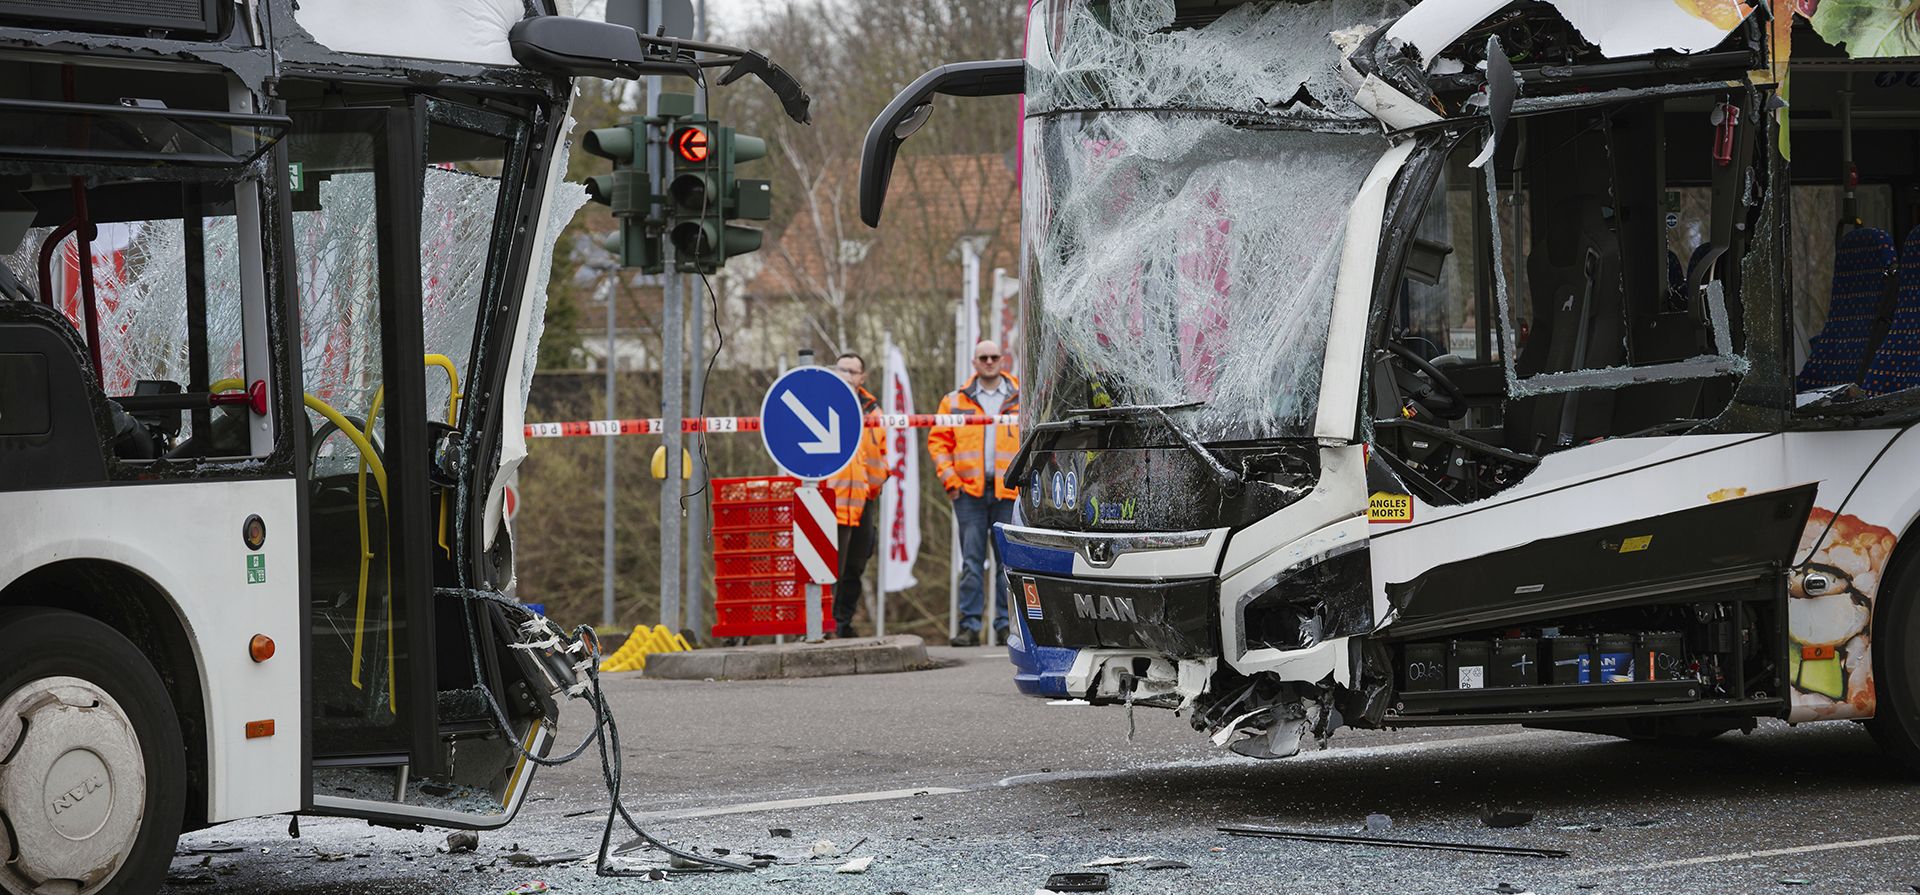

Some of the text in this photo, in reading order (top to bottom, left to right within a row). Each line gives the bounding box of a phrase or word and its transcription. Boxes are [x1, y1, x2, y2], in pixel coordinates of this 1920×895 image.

[1369, 499, 1407, 508] ANGLES
[1371, 509, 1406, 517] MORTS
[1074, 593, 1139, 624] MAN
[52, 776, 104, 815] MAN
